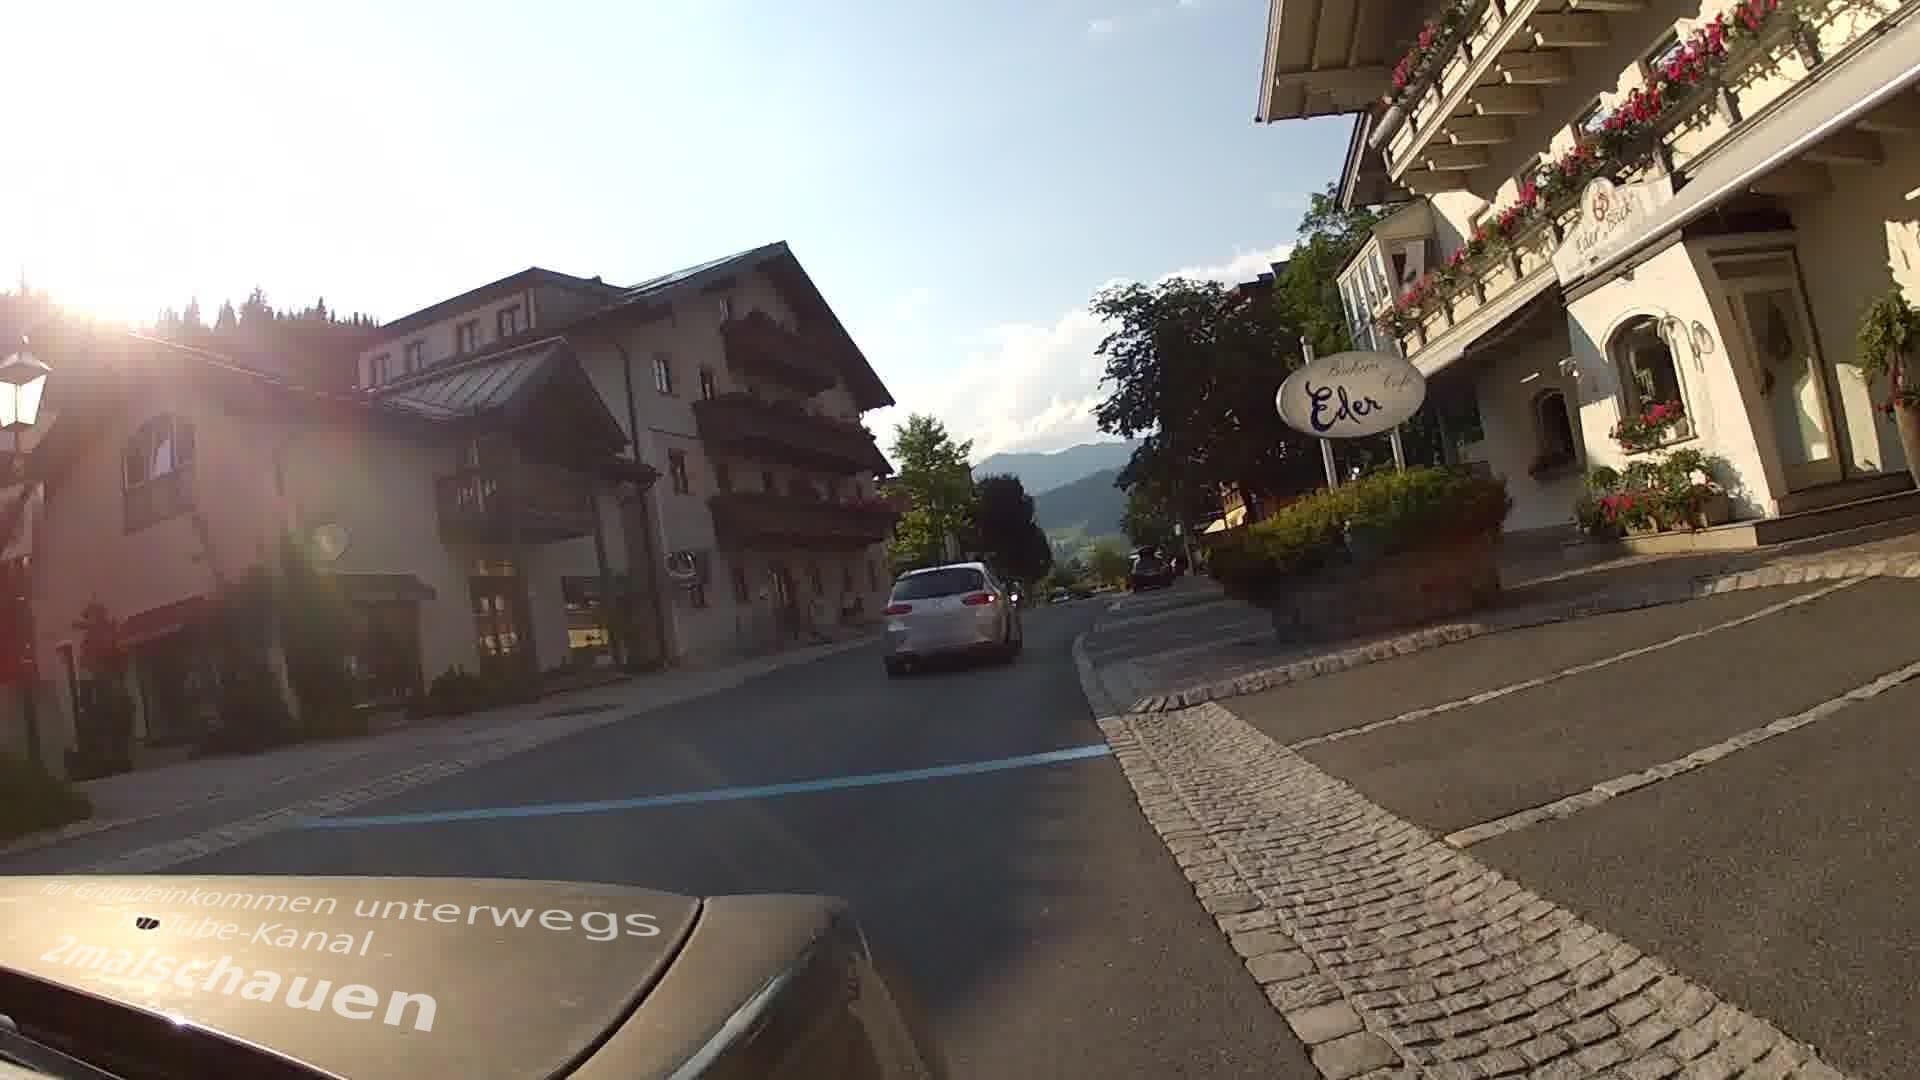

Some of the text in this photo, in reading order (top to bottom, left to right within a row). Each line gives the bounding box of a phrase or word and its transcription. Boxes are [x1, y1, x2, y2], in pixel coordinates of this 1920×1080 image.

[1305, 381, 1383, 432] Eder
[353, 898, 662, 942] unterwegs
[39, 934, 437, 1032] 2malschauen
